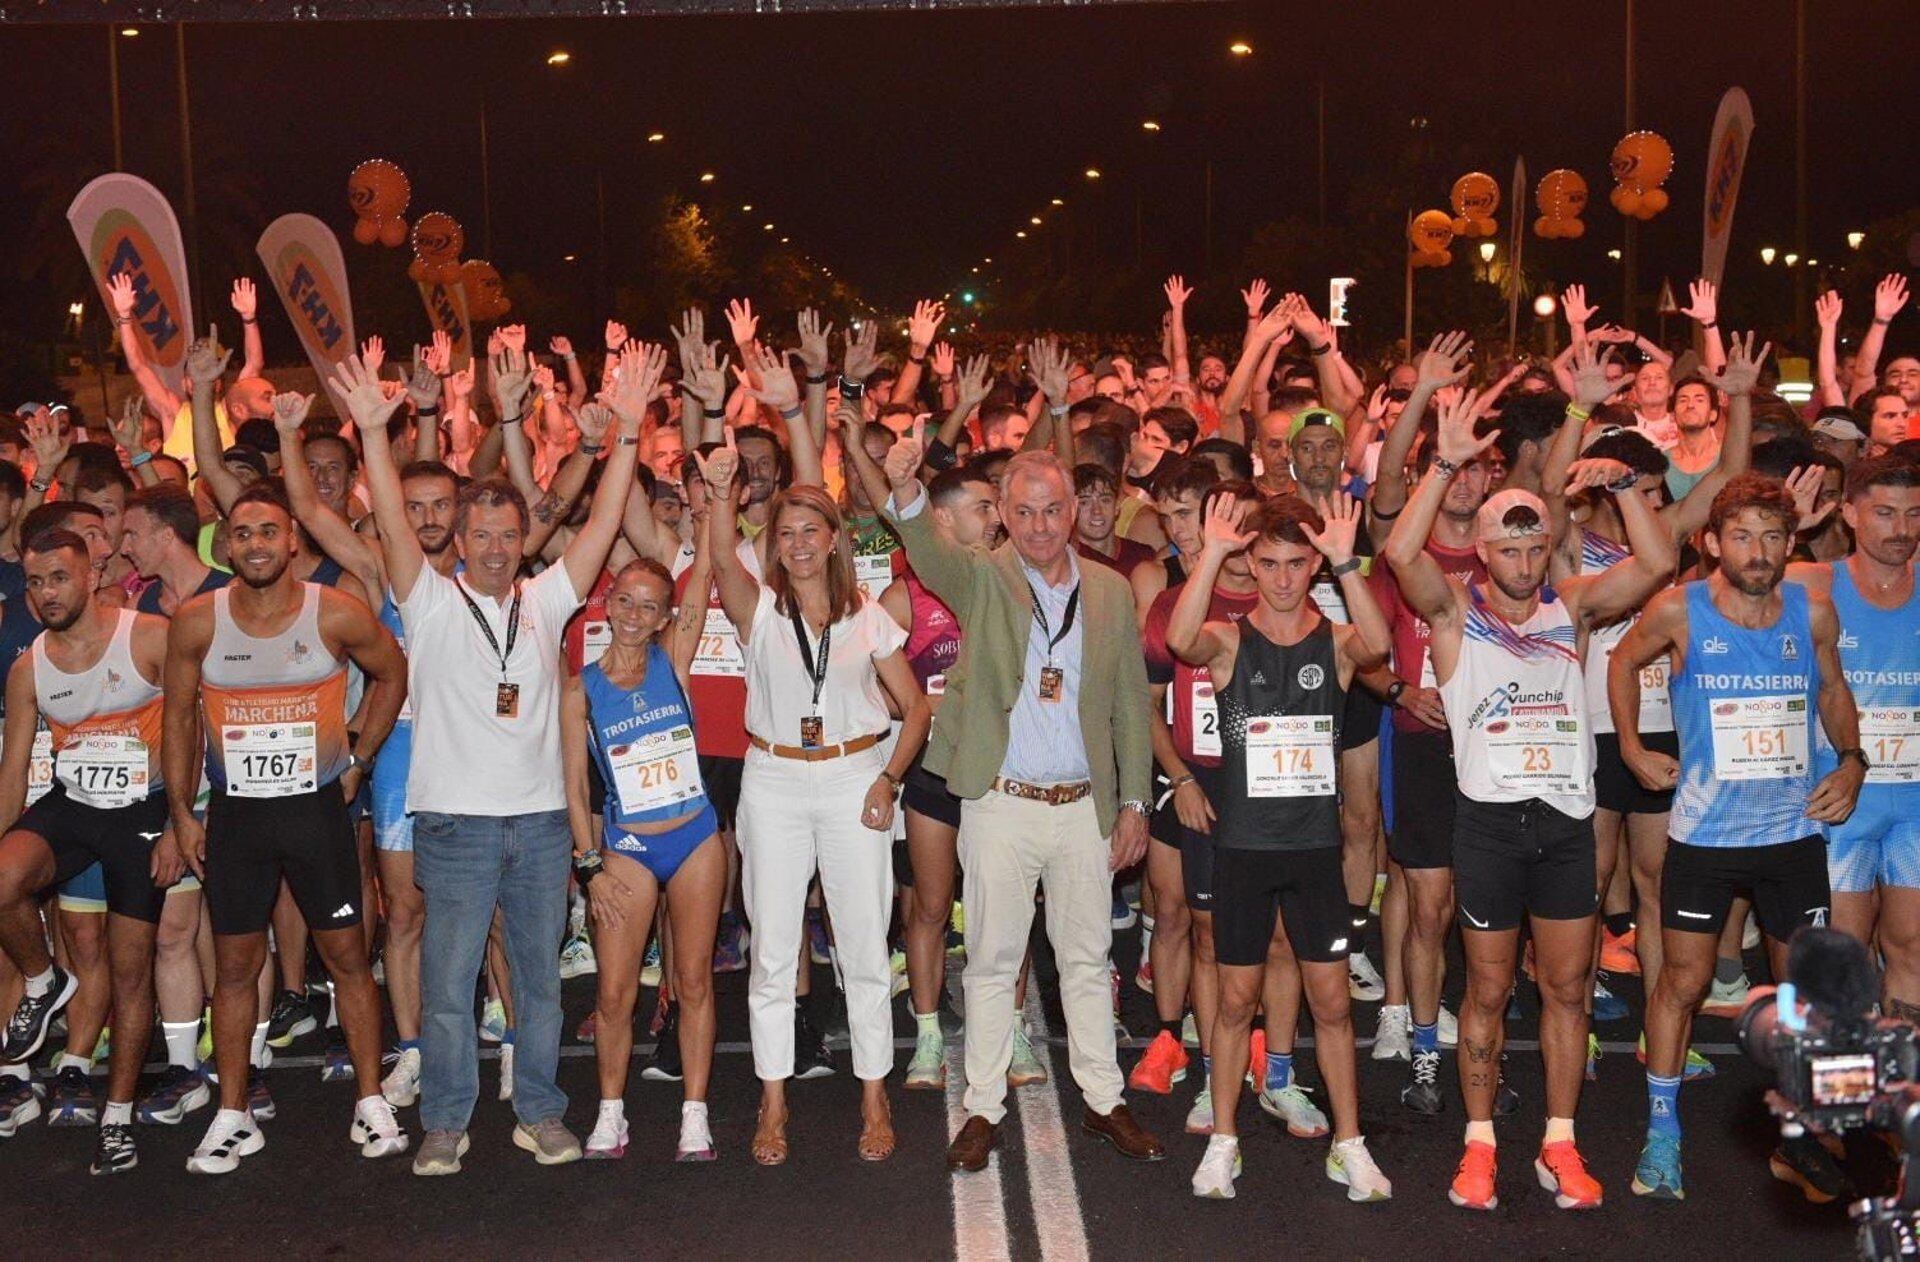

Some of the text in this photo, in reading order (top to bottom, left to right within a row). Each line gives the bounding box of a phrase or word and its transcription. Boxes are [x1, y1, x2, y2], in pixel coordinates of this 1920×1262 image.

[289, 262, 342, 350] KH7
[1694, 674, 1808, 690] TROTASIERRA
[224, 702, 318, 722] MARCHENA
[602, 704, 684, 739] TROTASIERRA
[1467, 698, 1491, 730] Jerez
[1742, 729, 1786, 755] 151
[1875, 739, 1903, 762] 17
[243, 753, 298, 777] 1767
[1273, 748, 1314, 773] 174
[1523, 747, 1551, 771] 23
[74, 765, 129, 788] 1775
[637, 758, 678, 789] 276
